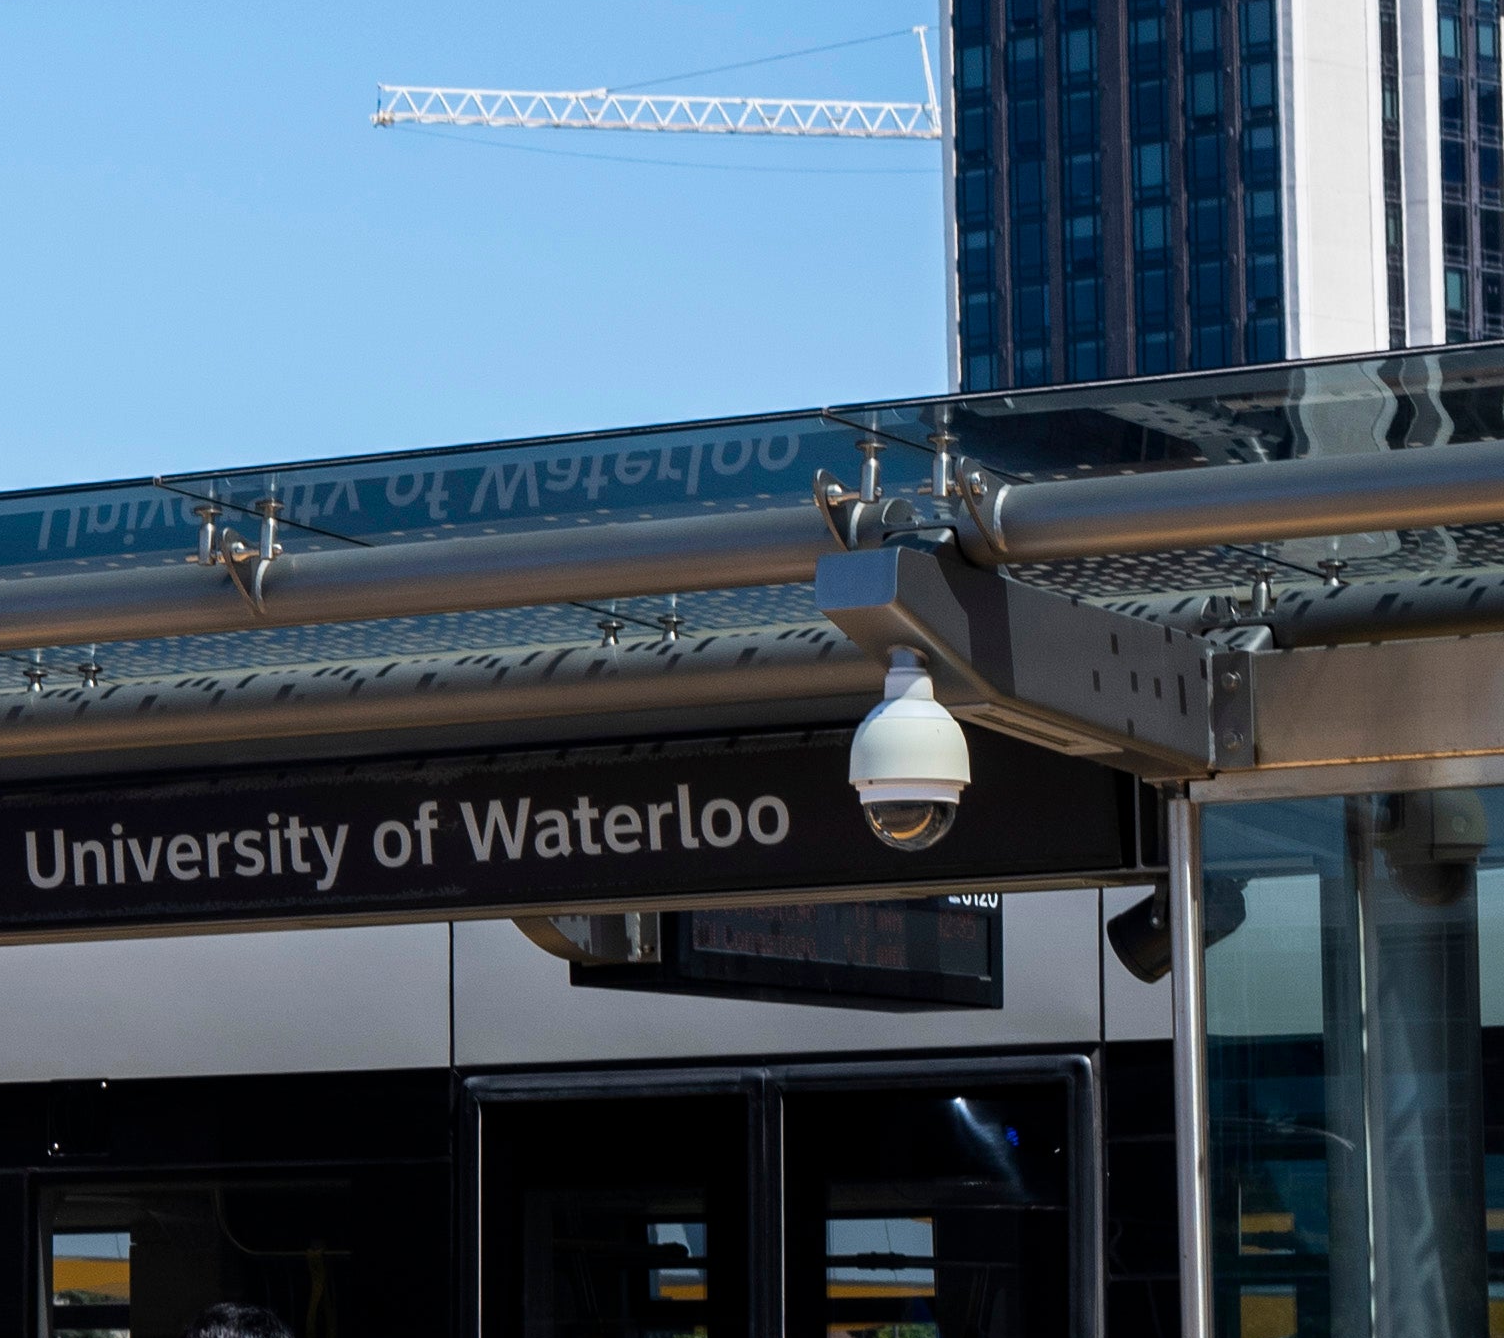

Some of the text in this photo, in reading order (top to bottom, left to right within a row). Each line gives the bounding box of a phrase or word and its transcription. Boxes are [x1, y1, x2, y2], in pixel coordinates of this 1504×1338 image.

[24, 785, 790, 891] University of Waterloo
